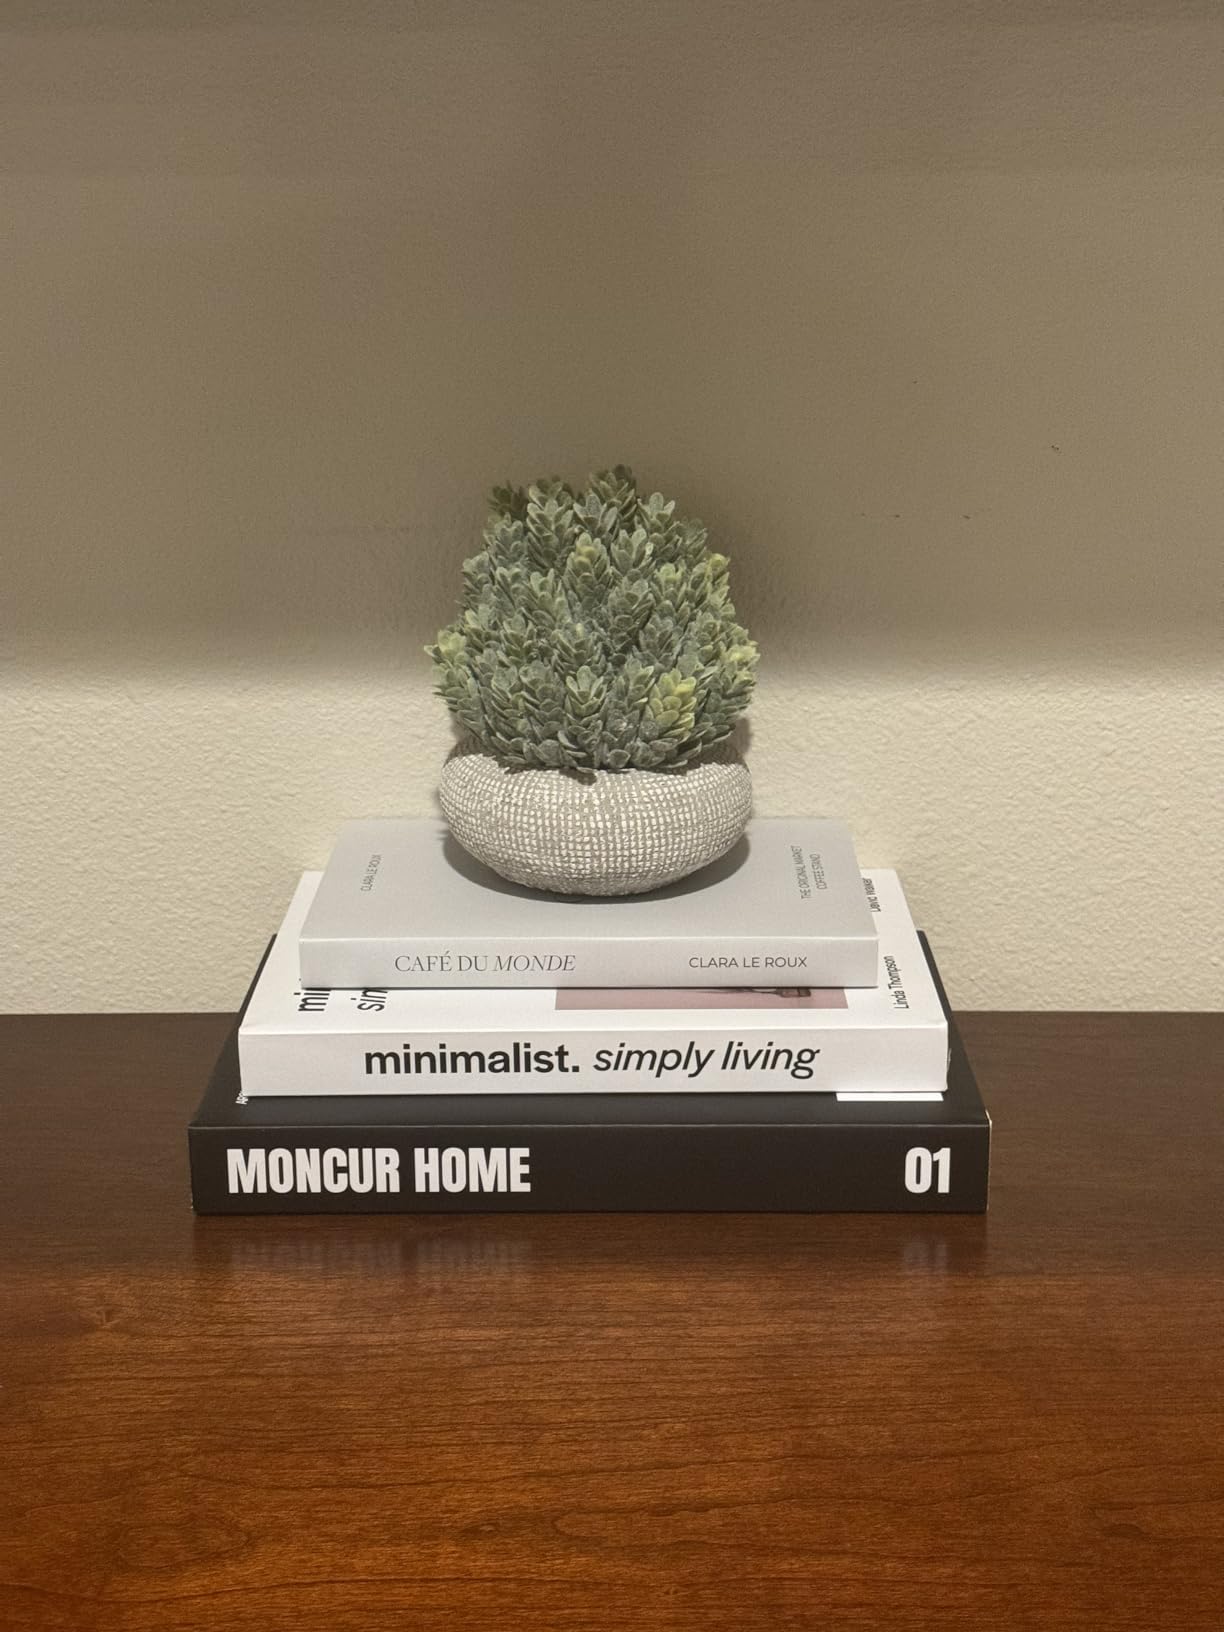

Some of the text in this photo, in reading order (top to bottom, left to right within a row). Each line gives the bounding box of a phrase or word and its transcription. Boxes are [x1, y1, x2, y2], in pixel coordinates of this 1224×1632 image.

[790, 844, 812, 900] THE ORIGINAL MARKET
[809, 853, 823, 871] STAND
[394, 950, 576, 972] CAFÉ DU MONDE
[688, 956, 808, 968] CLARA LE ROUX
[883, 955, 909, 1009] Linda Thompson
[364, 1041, 820, 1079] minimalist. simply living
[226, 1147, 531, 1194] MONCUR HOME
[904, 1146, 951, 1194] 01
